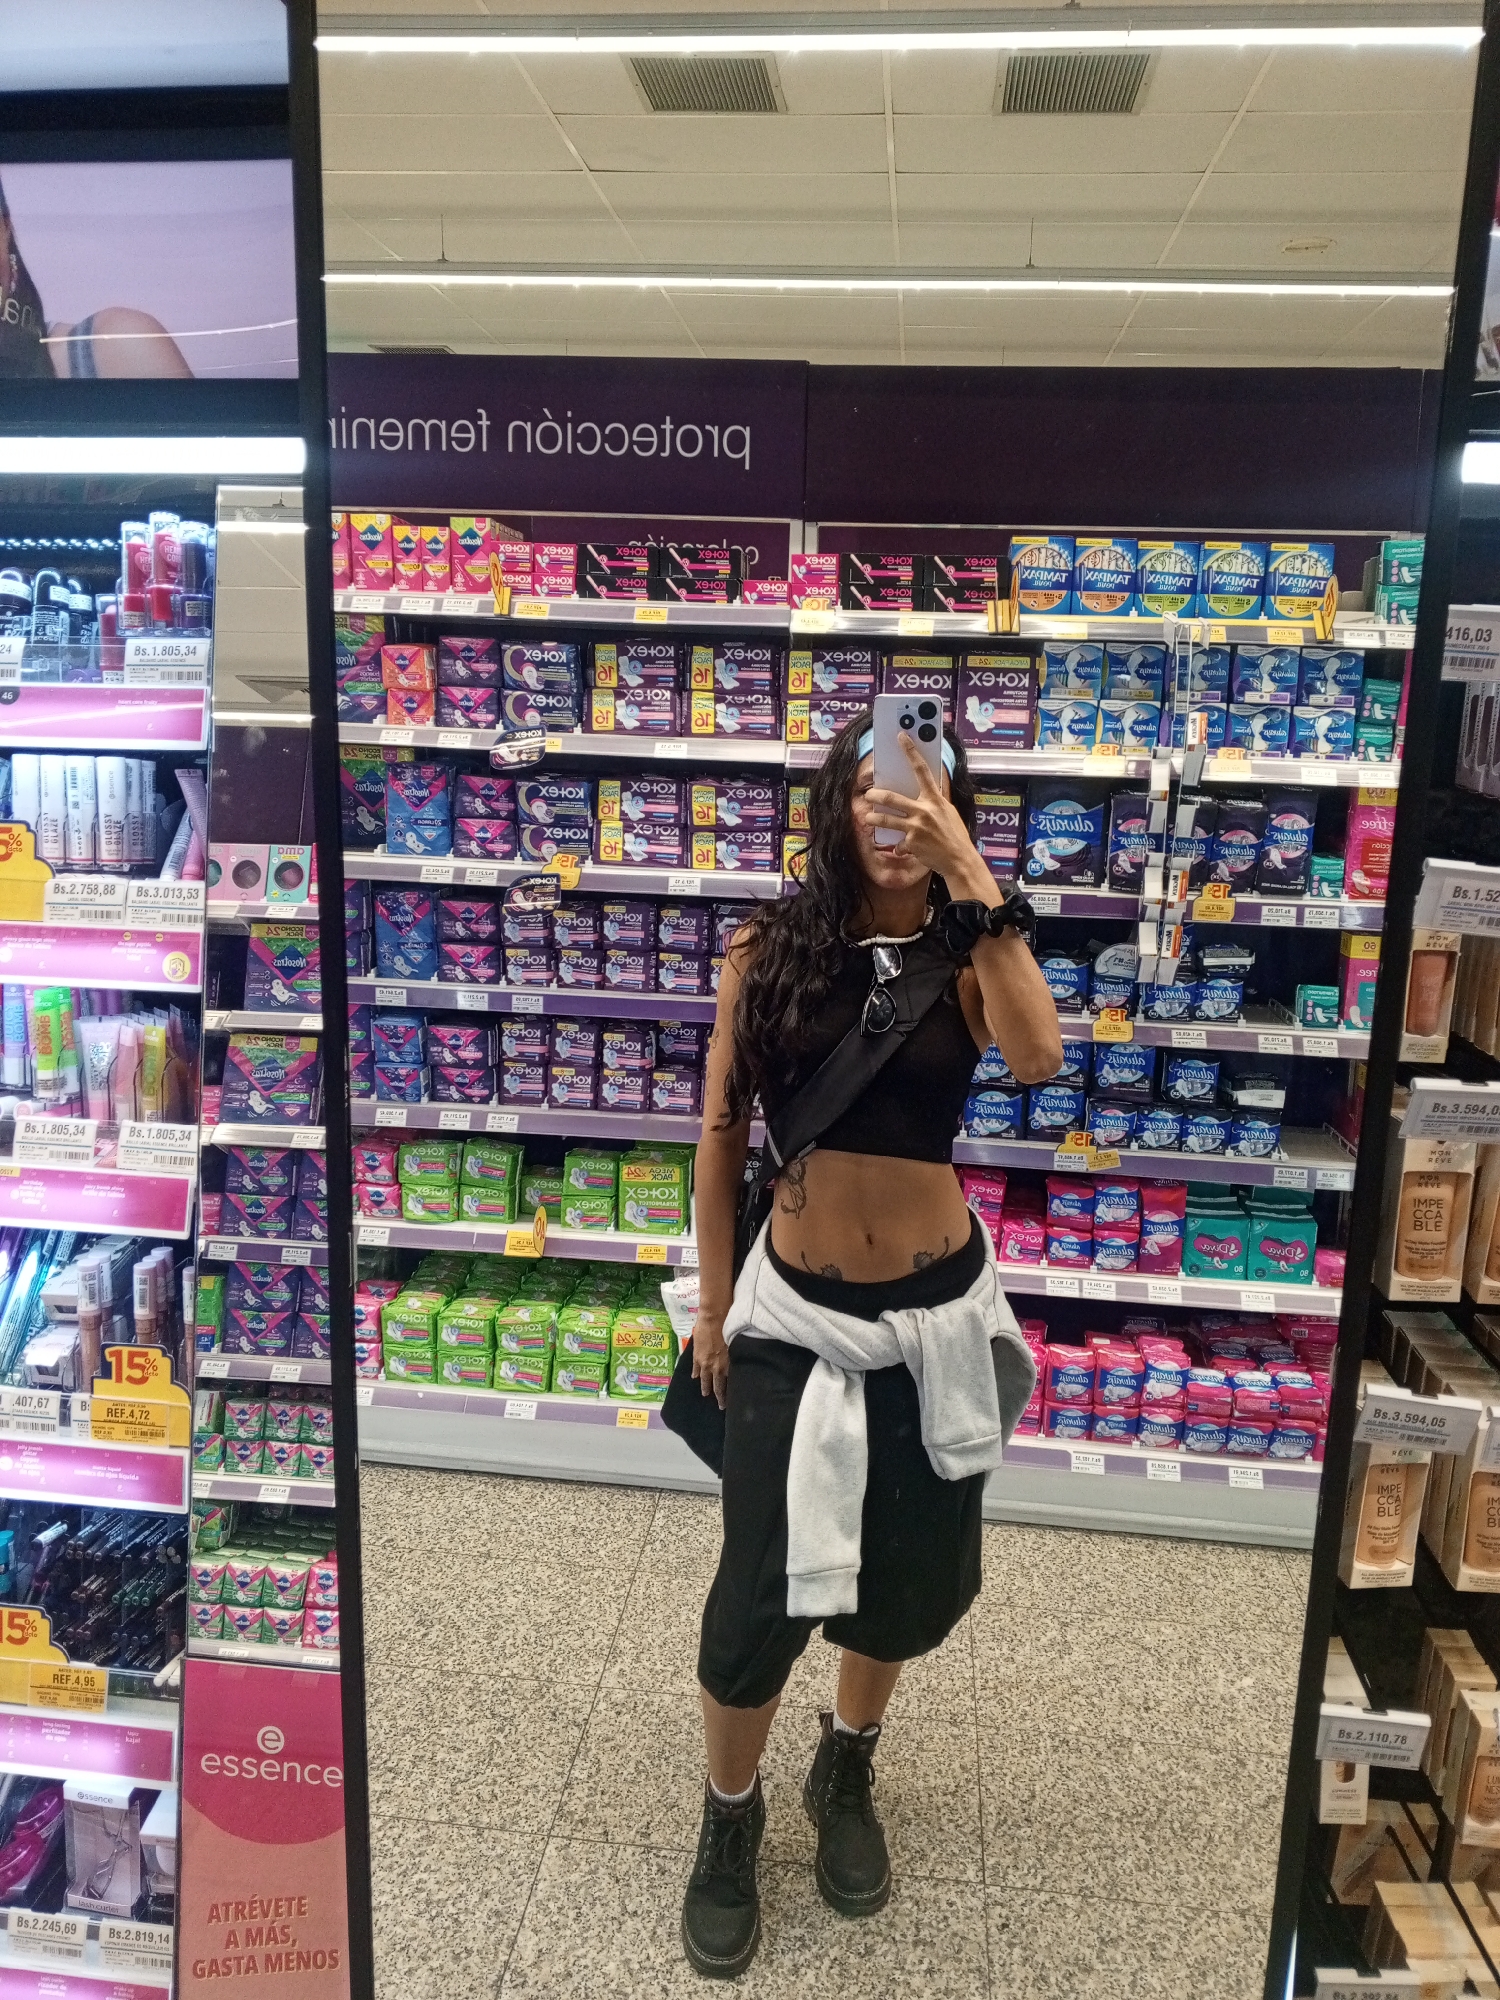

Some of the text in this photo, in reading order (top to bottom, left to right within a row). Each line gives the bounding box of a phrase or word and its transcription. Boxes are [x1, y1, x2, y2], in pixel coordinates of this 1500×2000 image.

[134, 645, 197, 657] Bs.1.805,34
[104, 813, 112, 846] GLOSSY
[53, 884, 116, 897] Bs.2.758,88
[136, 886, 199, 900] Bs.3.013,53
[1432, 1102, 1500, 1116] Bs.3.594,0
[24, 1123, 86, 1136] Bs.1.805,34
[129, 1126, 192, 1141] Bs.1.805,34
[1413, 1198, 1444, 1209] IMPE
[1413, 1210, 1443, 1220] CCA
[1414, 1220, 1442, 1231] BLE
[106, 1407, 150, 1421] REF.4,72
[1373, 1408, 1447, 1428] Bs.3.594,05
[52, 1673, 95, 1688] REF.4,95
[1338, 1728, 1408, 1746] Bs.2.110,78
[200, 1752, 344, 1788] essence
[77, 1791, 113, 1804] essence
[207, 1894, 309, 1925] ATRÉVETE
[17, 1916, 77, 1935] Bs.2.245,69
[109, 1927, 170, 1945] Bs.2.819,14
[224, 1920, 298, 1950] A MÁS,
[192, 1949, 341, 1980] GASTA MENOS
